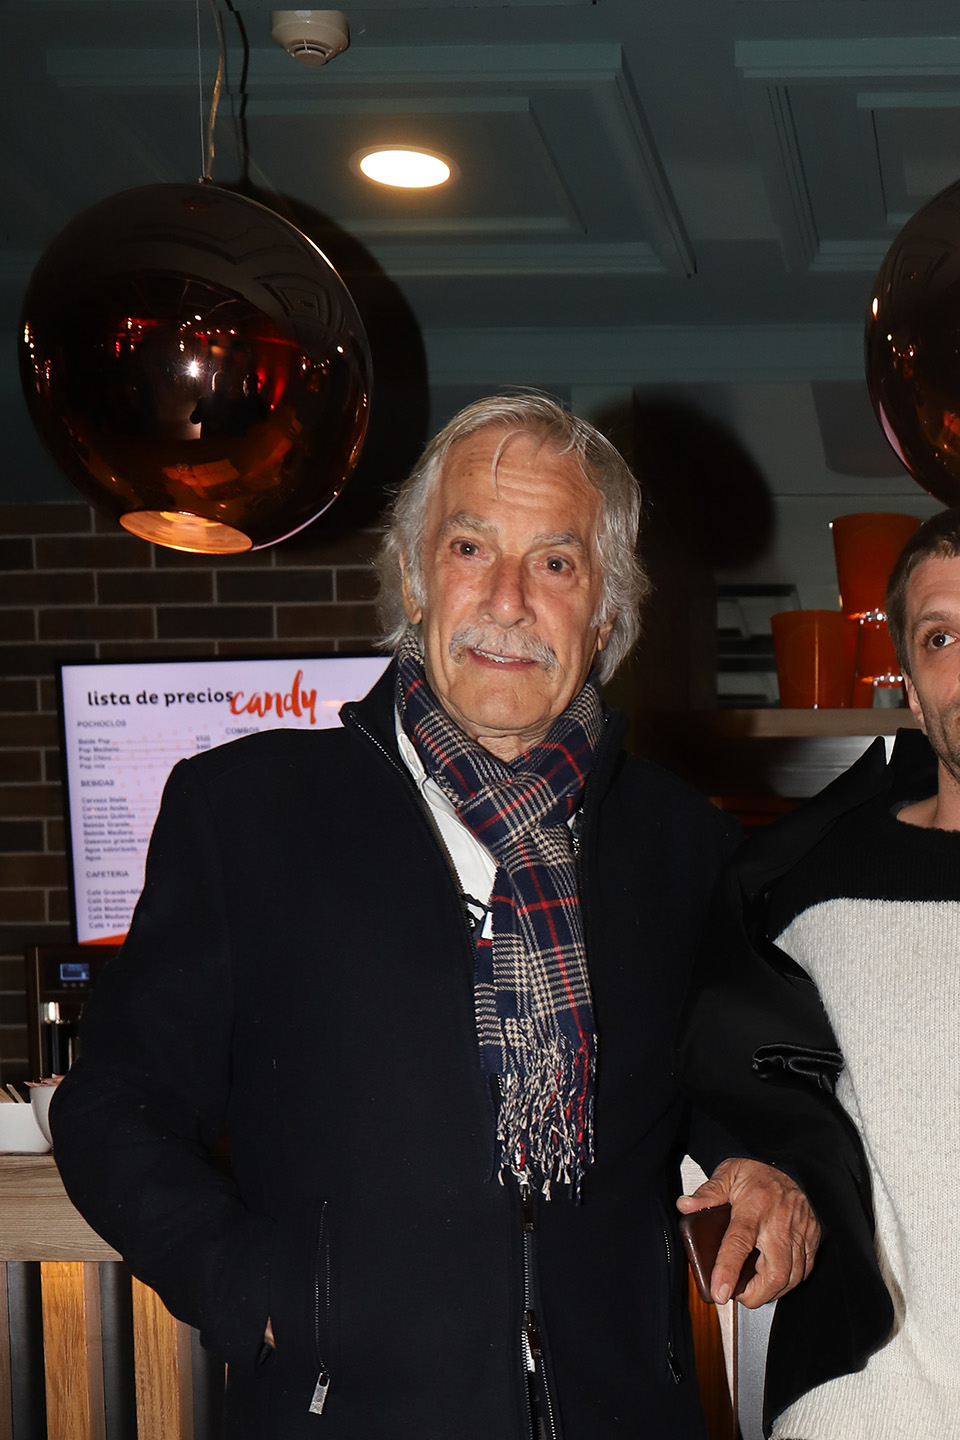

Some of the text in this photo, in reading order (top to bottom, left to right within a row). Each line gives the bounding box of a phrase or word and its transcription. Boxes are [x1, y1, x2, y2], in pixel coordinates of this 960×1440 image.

[87, 688, 233, 707] lista de precios
[230, 669, 317, 725] candy
[77, 719, 127, 728] POCHOCLOS
[225, 727, 260, 735] COMBOS
[80, 779, 115, 787] BEBIDAS
